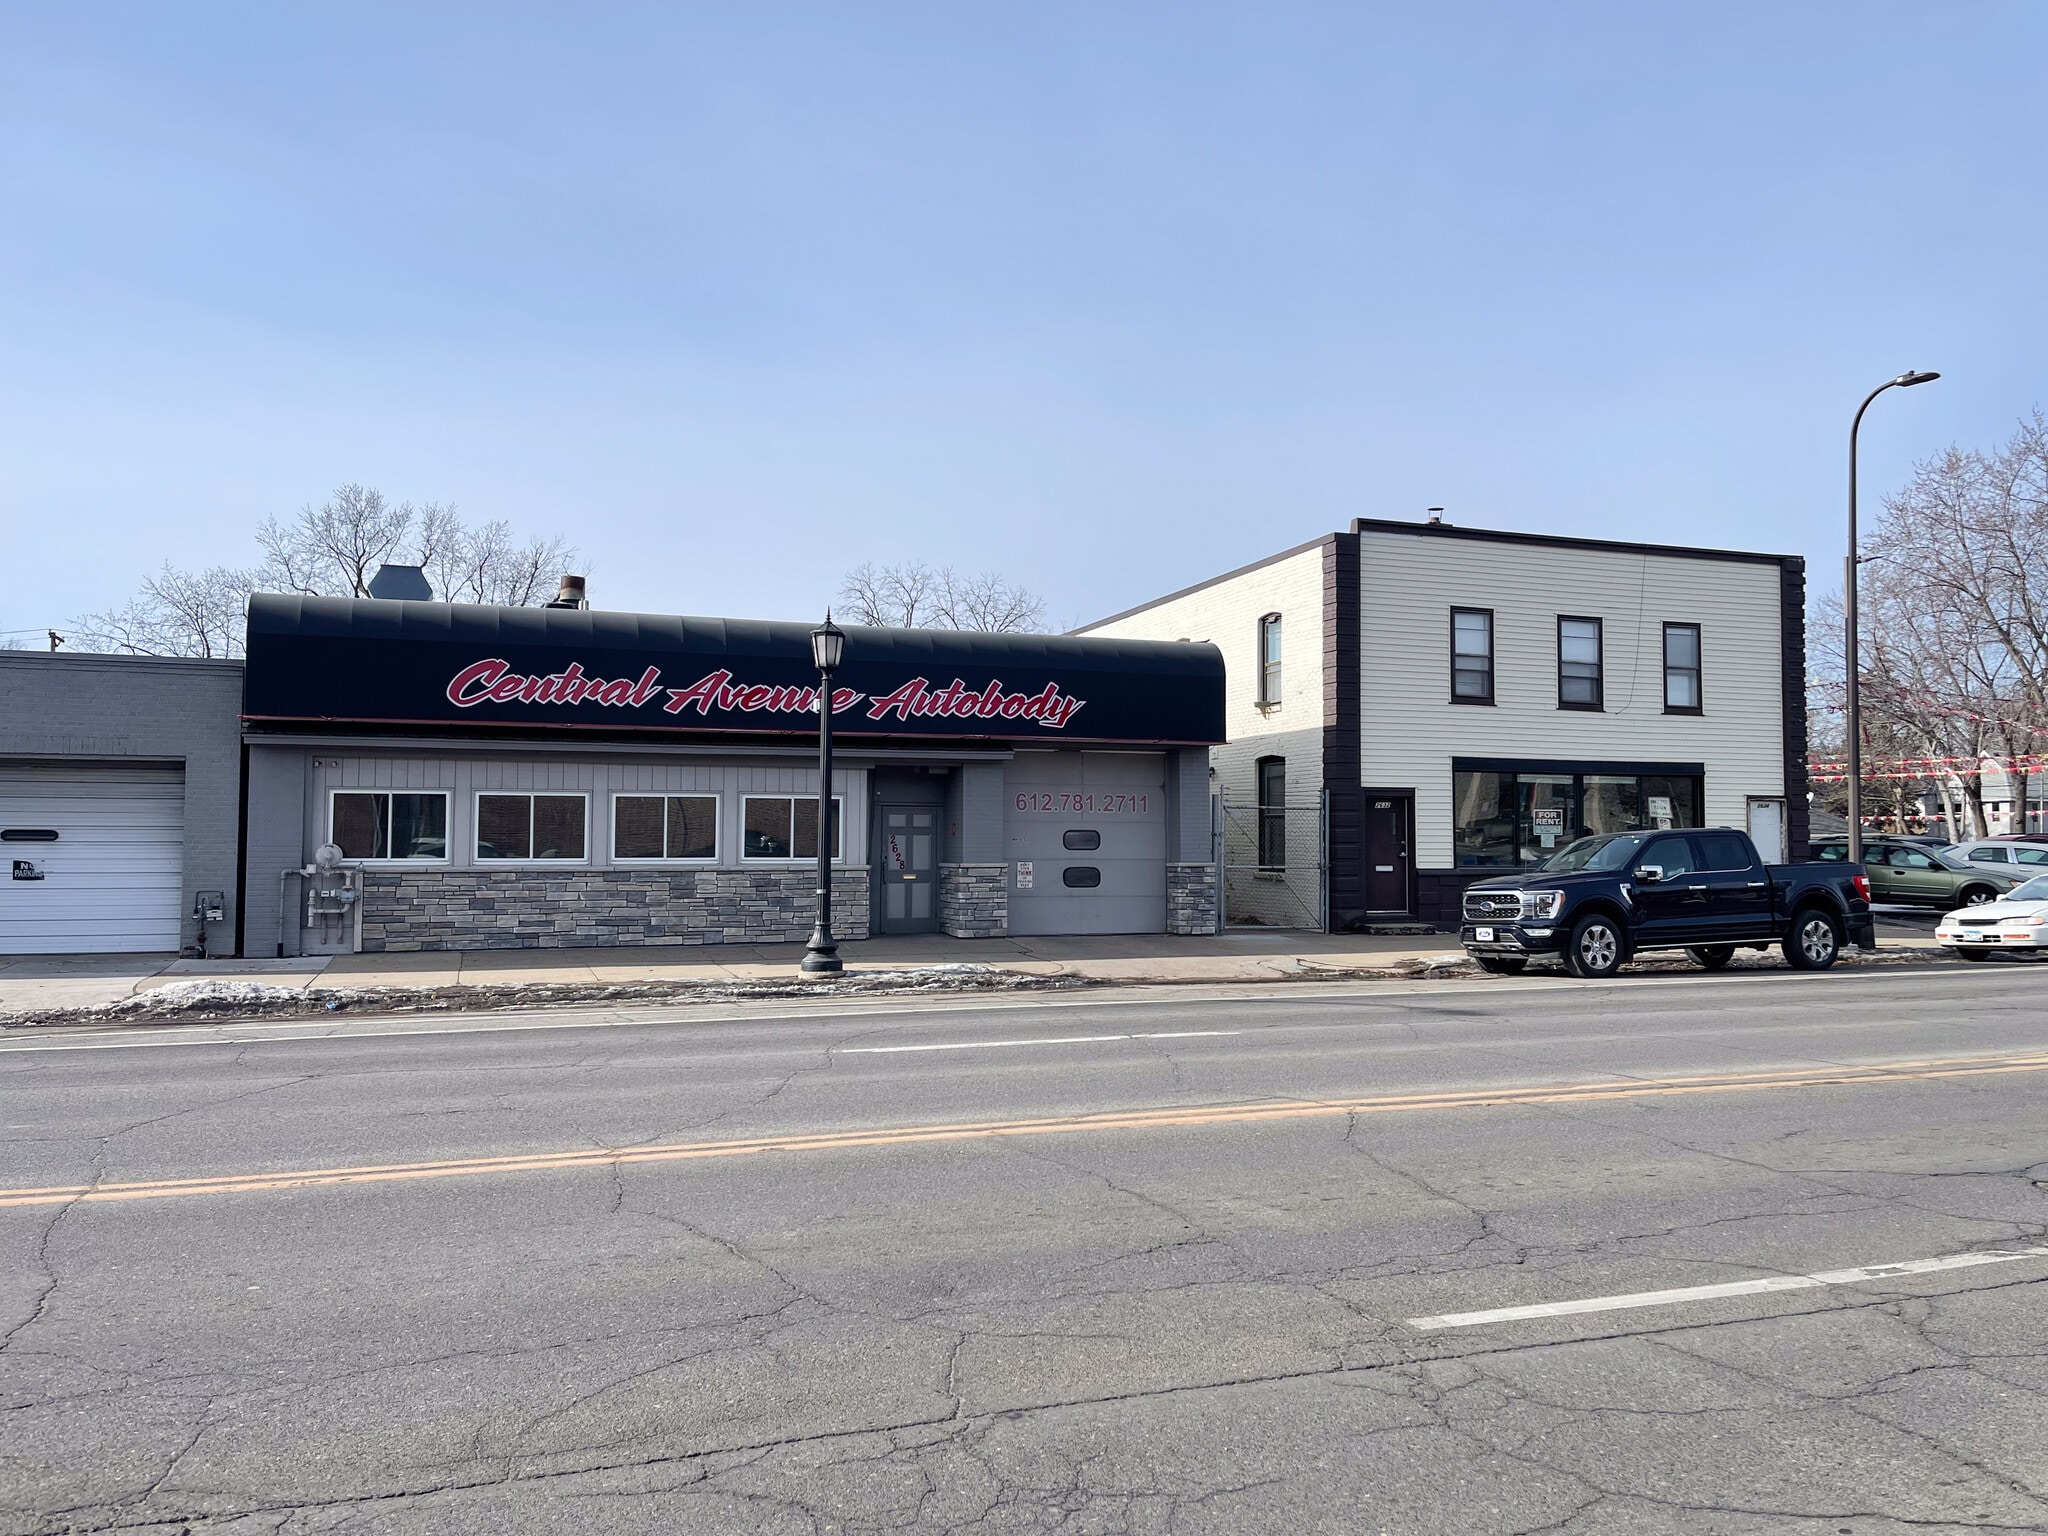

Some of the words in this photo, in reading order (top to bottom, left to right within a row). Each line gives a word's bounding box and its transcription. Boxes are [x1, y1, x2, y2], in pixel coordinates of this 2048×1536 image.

[447, 659, 664, 707] Central
[866, 676, 1087, 728] Autobody
[1014, 792, 1149, 813] 612.781.2711
[889, 834, 906, 870] 2628
